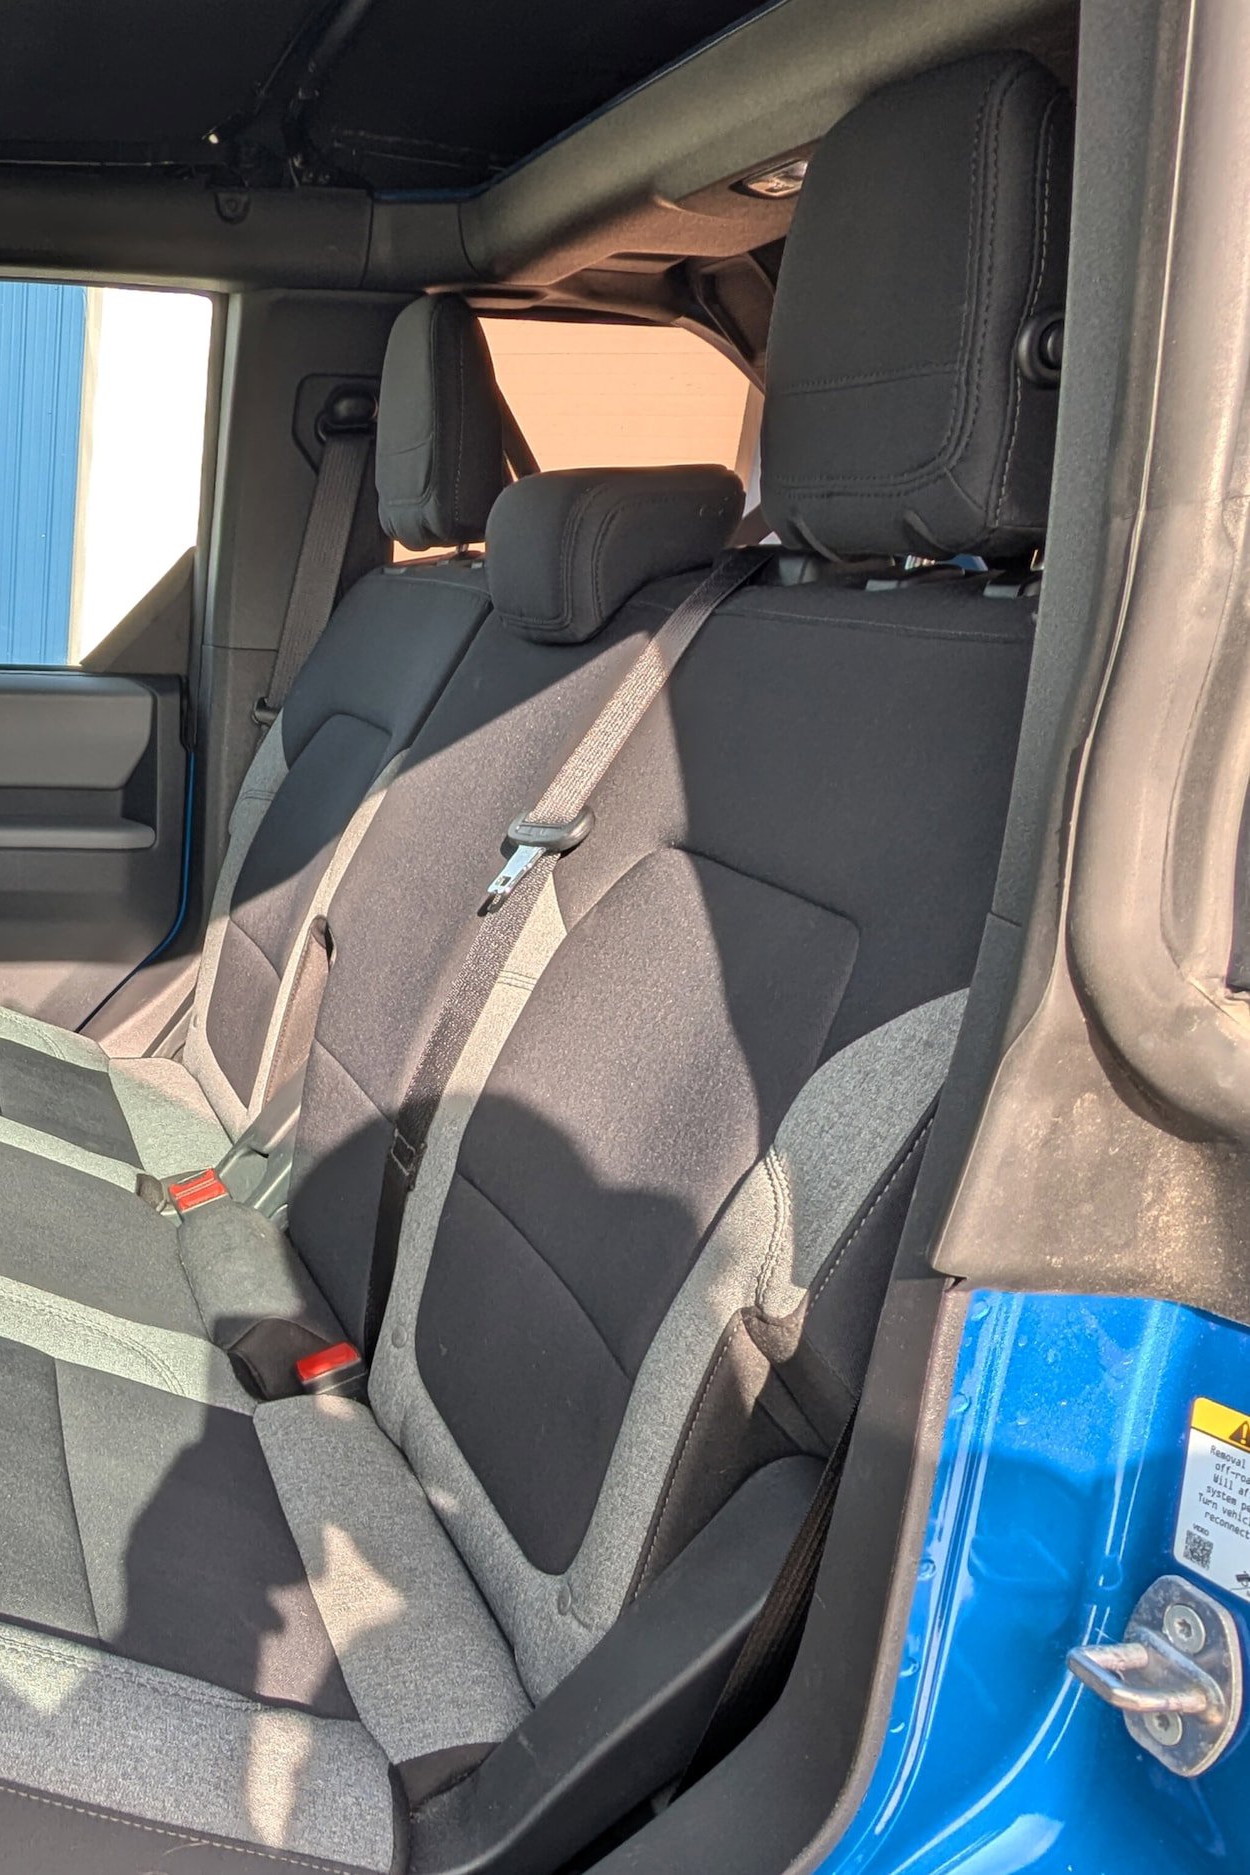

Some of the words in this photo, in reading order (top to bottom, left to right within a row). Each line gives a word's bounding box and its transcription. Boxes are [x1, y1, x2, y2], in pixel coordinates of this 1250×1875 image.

[1210, 1445, 1246, 1469] Removal
[1206, 1485, 1237, 1506] system
[1213, 1473, 1233, 1490] Will
[1238, 1487, 1250, 1497] af
[1198, 1492, 1218, 1510] Turn
[1193, 1523, 1210, 1537] VIDEO
[1204, 1511, 1250, 1540] reconnect
